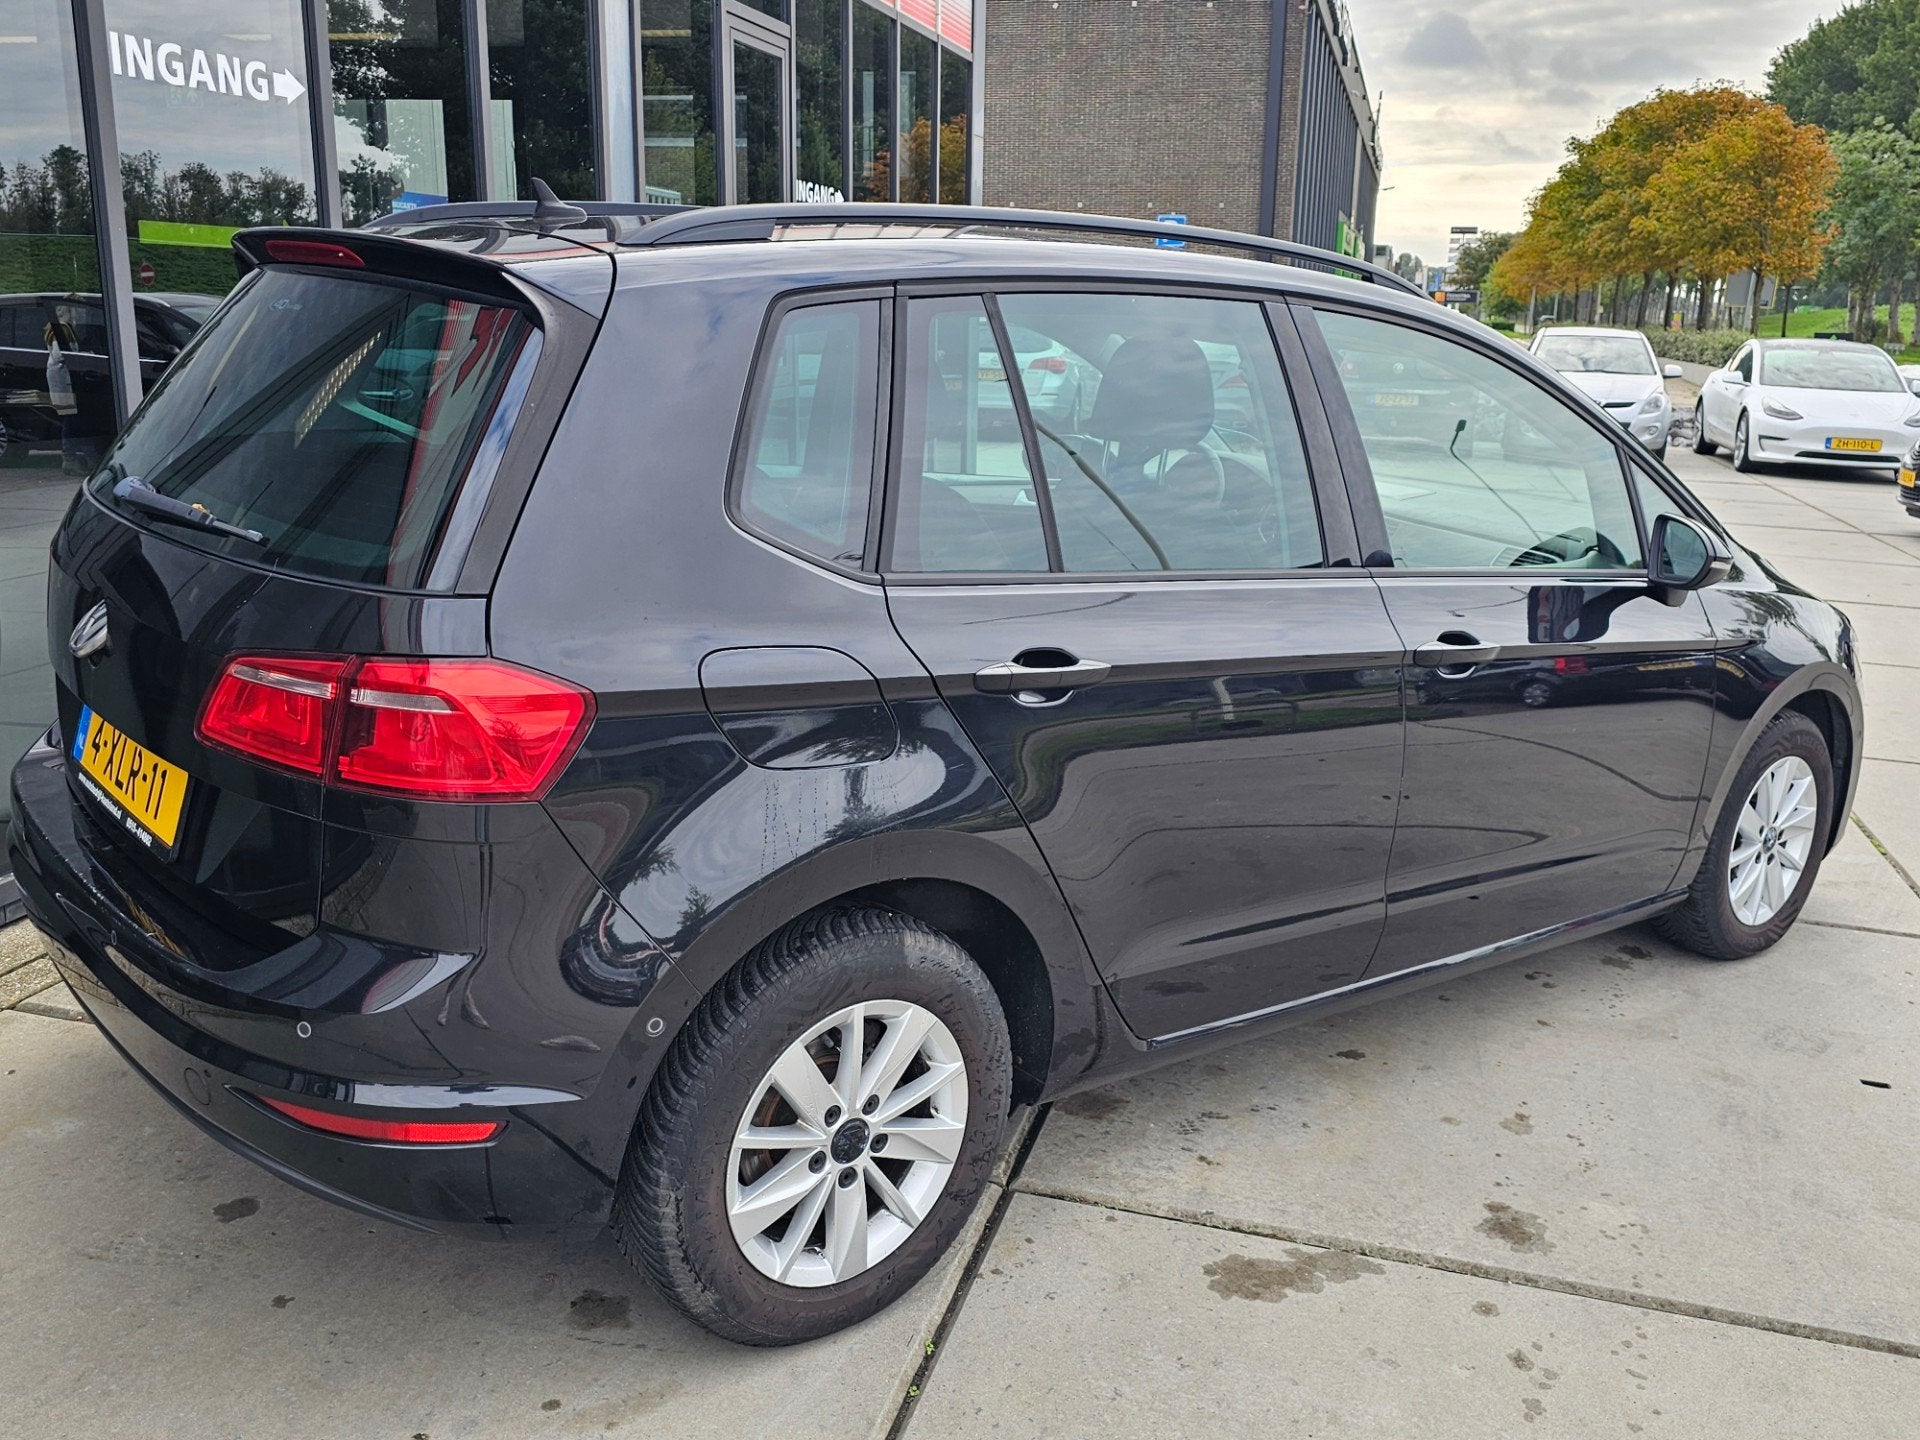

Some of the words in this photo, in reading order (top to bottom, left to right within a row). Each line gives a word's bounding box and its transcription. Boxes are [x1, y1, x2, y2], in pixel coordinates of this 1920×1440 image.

[109, 31, 270, 101] INGANG
[795, 179, 835, 203] INGANG
[1836, 439, 1875, 450] ZH-110-L
[91, 719, 168, 820] 4-XLR-11
